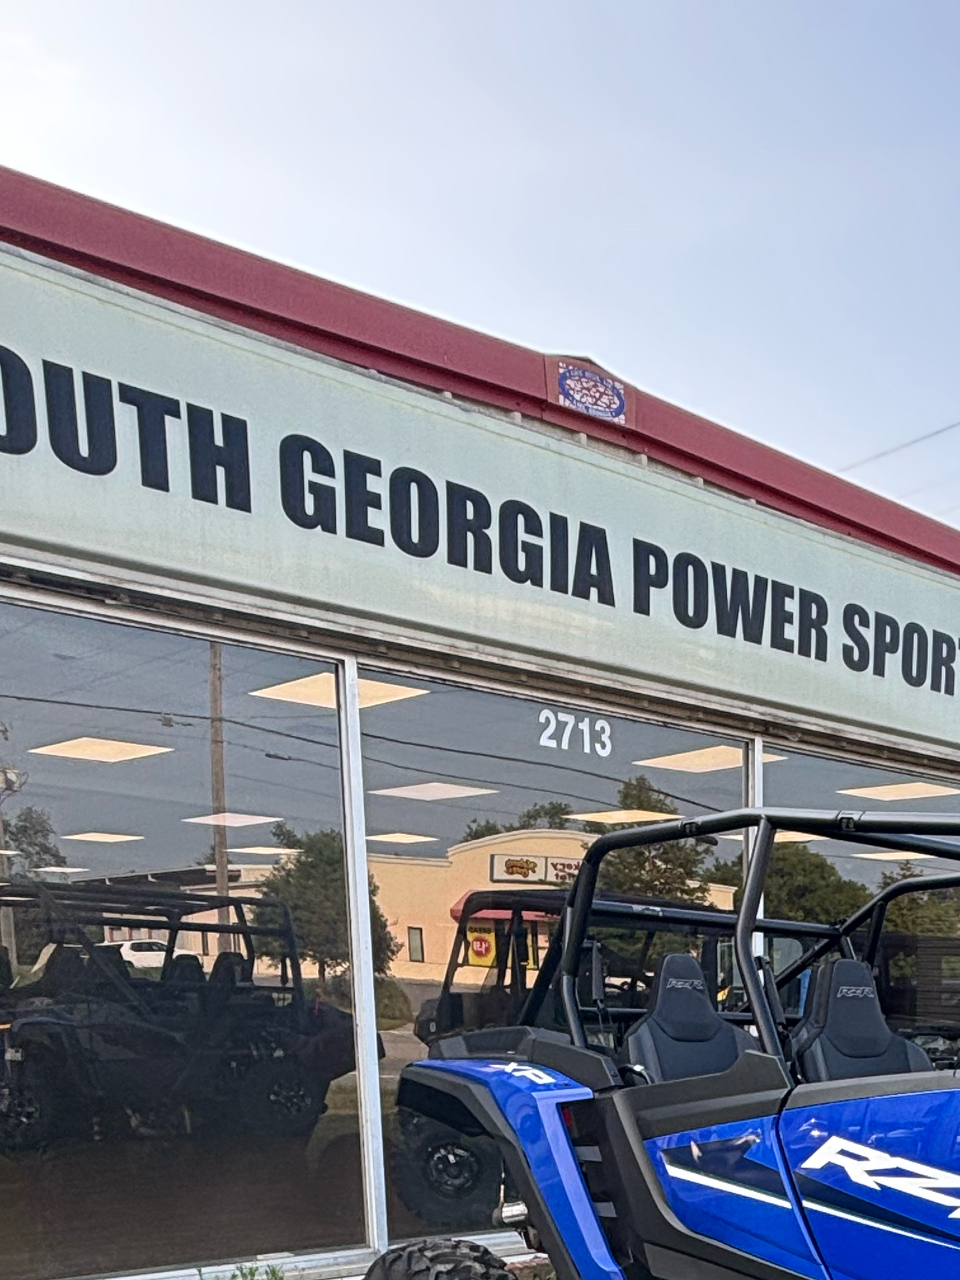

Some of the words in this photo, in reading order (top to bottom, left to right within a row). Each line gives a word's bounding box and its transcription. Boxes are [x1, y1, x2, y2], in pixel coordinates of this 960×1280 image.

[279, 434, 616, 609] GEORGIA
[632, 537, 828, 663] POWER
[538, 709, 612, 758] 2713
[666, 978, 704, 990] RZR
[837, 986, 875, 998] RZR
[488, 1061, 557, 1085] XP
